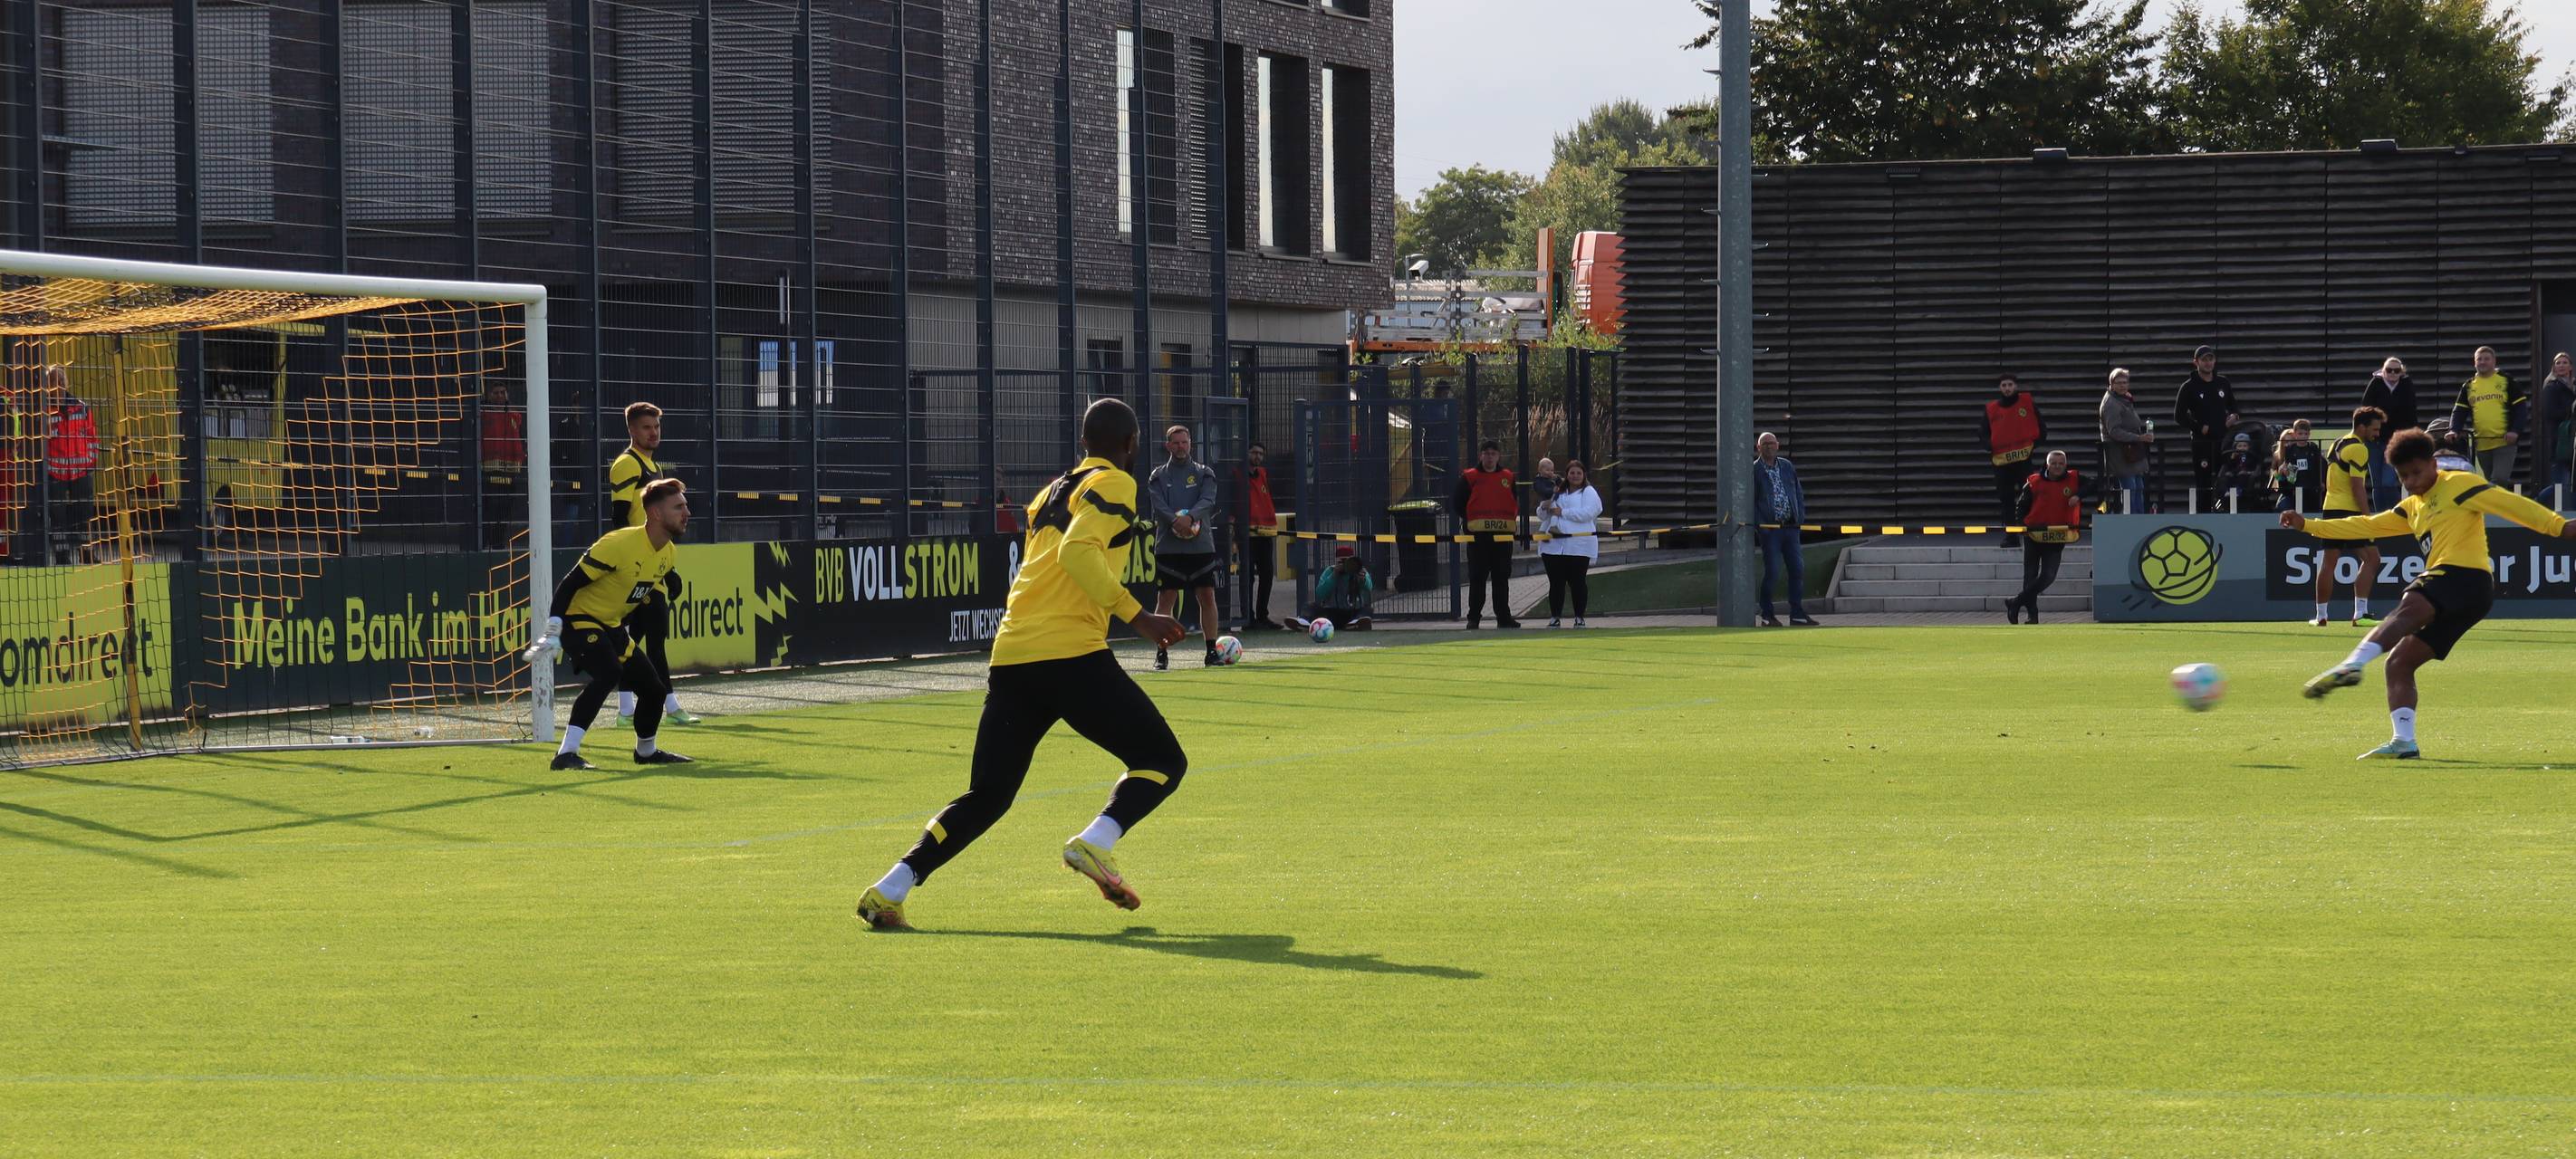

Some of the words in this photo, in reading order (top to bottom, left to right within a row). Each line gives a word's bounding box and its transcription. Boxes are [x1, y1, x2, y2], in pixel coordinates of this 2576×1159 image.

[1484, 521, 1507, 530] BR/24
[816, 547, 843, 604] BVB
[2526, 546, 2576, 594] Ju
[234, 598, 335, 670] Meine
[346, 593, 424, 662] Bank
[432, 590, 468, 656] im
[949, 610, 970, 643] JETZT
